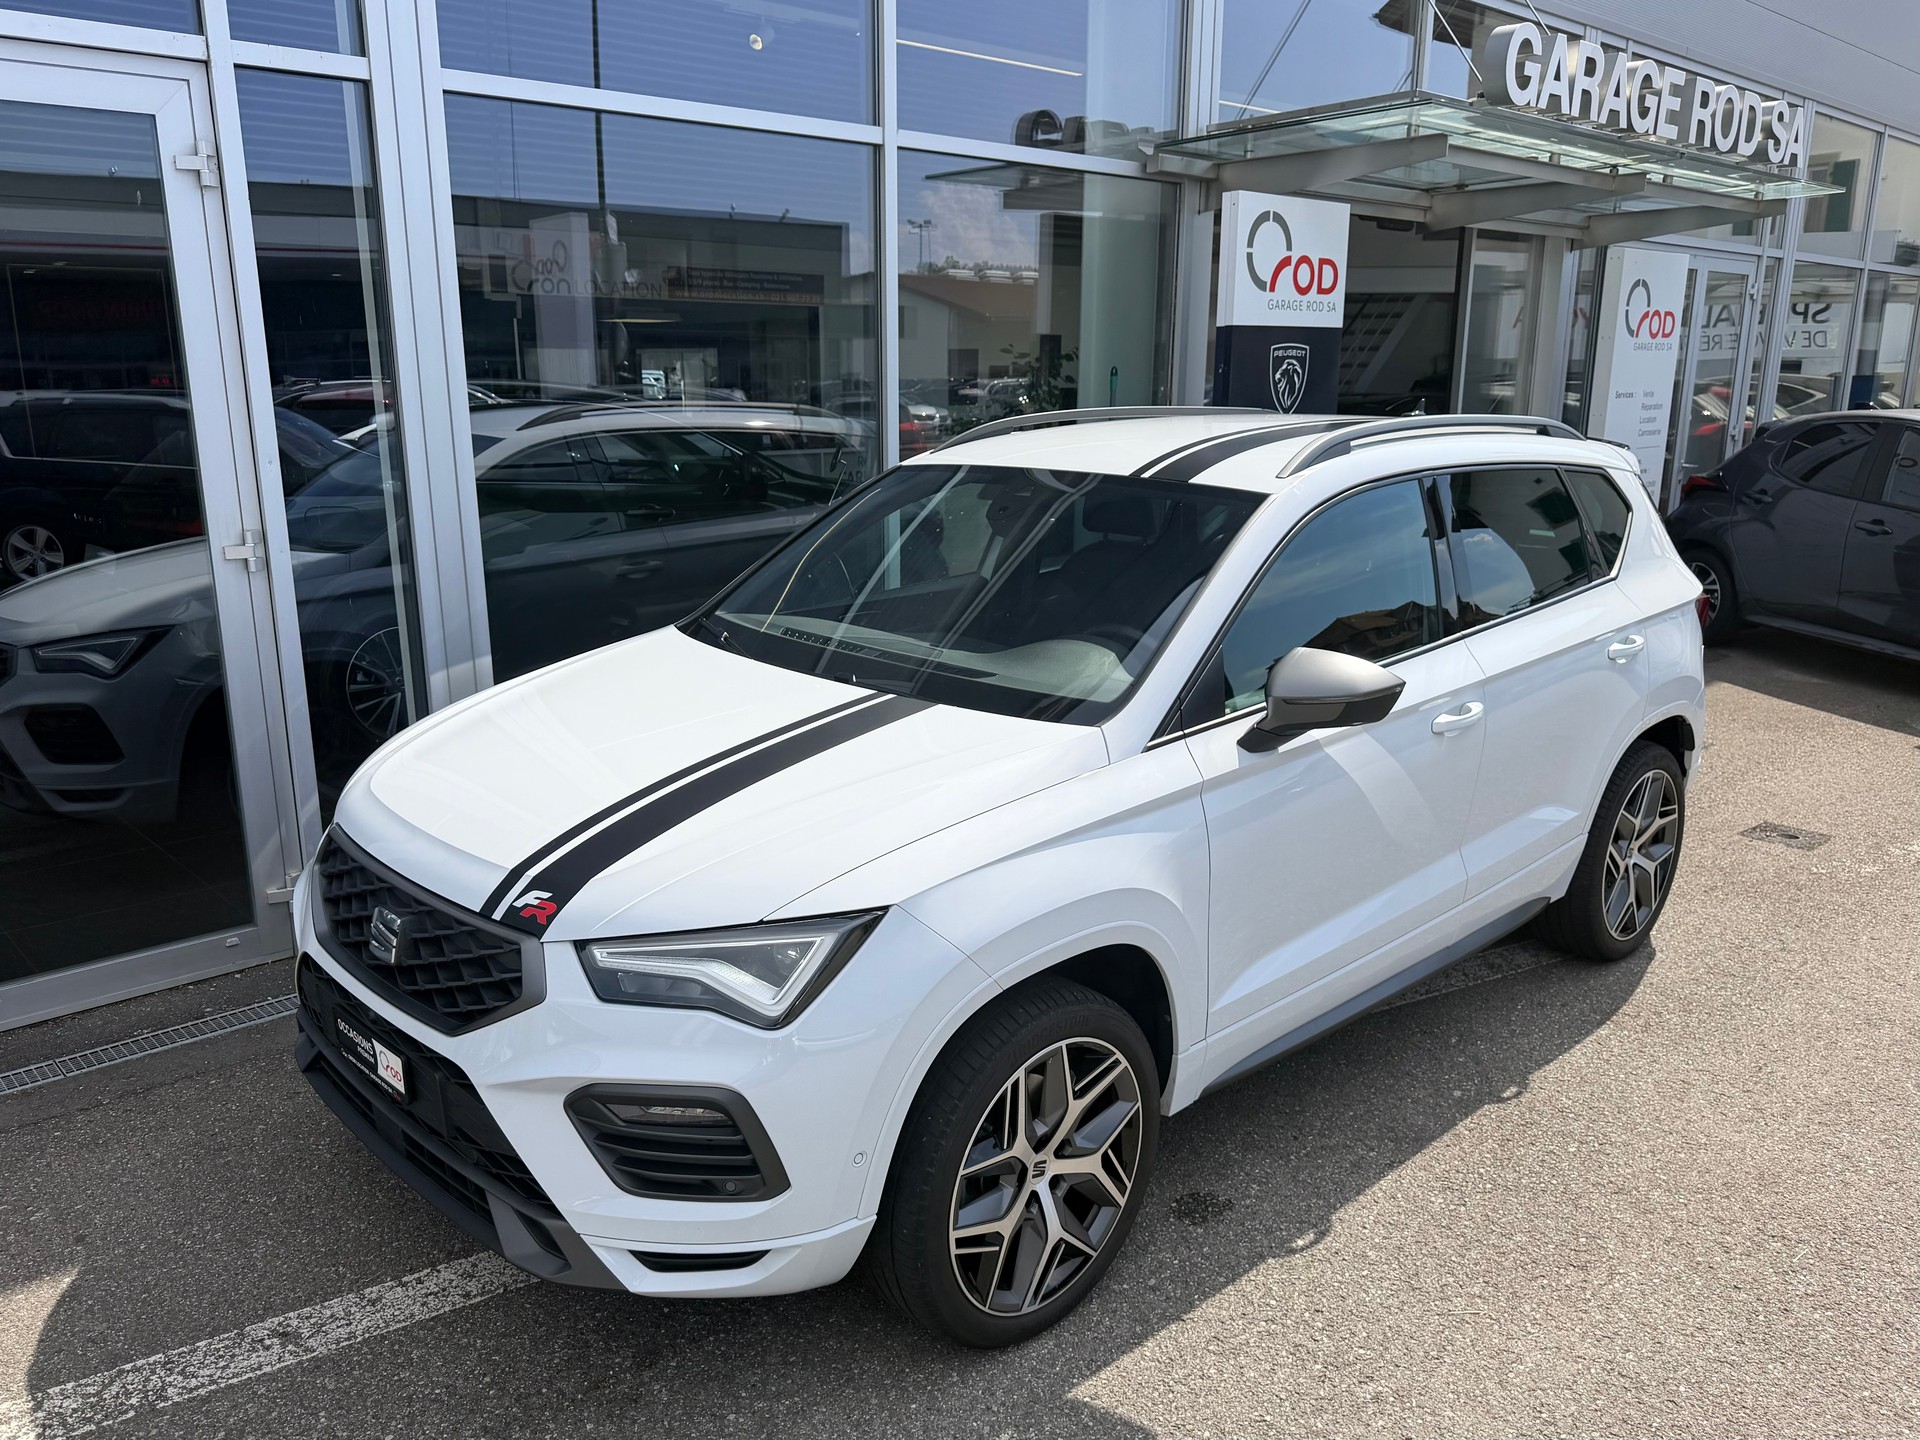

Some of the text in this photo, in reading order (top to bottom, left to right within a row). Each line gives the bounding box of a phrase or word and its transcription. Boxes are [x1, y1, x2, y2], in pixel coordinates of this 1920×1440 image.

[1506, 22, 1804, 169] GARAGE ROD SA
[574, 278, 662, 299] LOCATION
[1267, 299, 1337, 313] GARAGE ROD SA
[1273, 349, 1306, 358] PEUGEOT
[1632, 342, 1654, 351] GARAGE
[1654, 342, 1666, 351] ROD
[512, 890, 557, 926] FR
[337, 1018, 374, 1055] OCCASIONS
